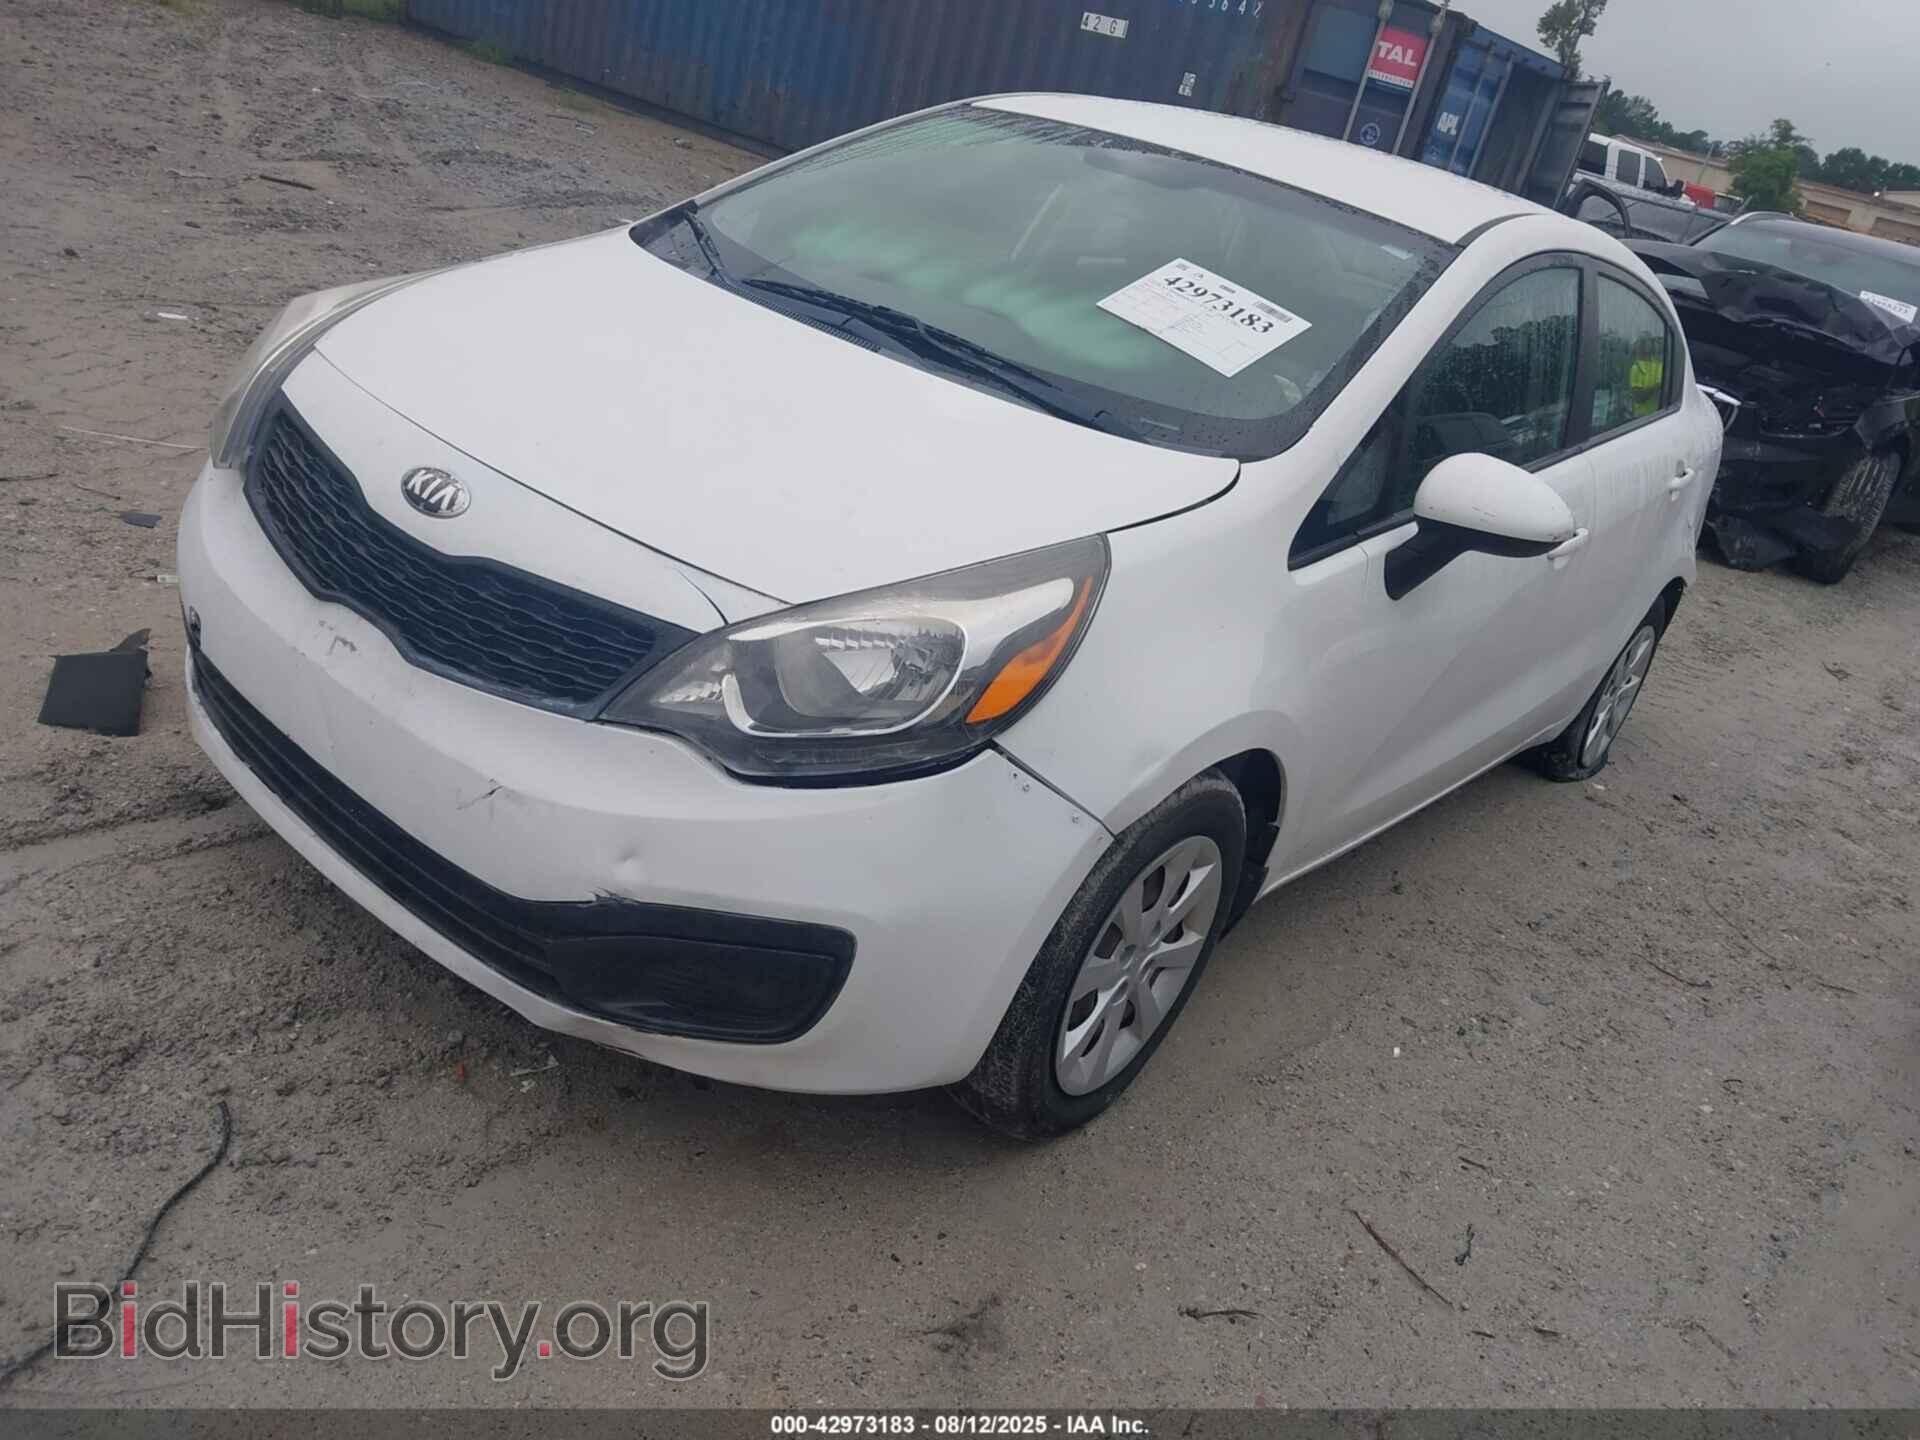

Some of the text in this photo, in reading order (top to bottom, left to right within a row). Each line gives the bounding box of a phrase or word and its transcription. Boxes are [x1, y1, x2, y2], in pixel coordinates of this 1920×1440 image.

[1377, 41, 1416, 67] TAL
[1164, 276, 1274, 334] 42973183
[407, 469, 457, 512] KIA
